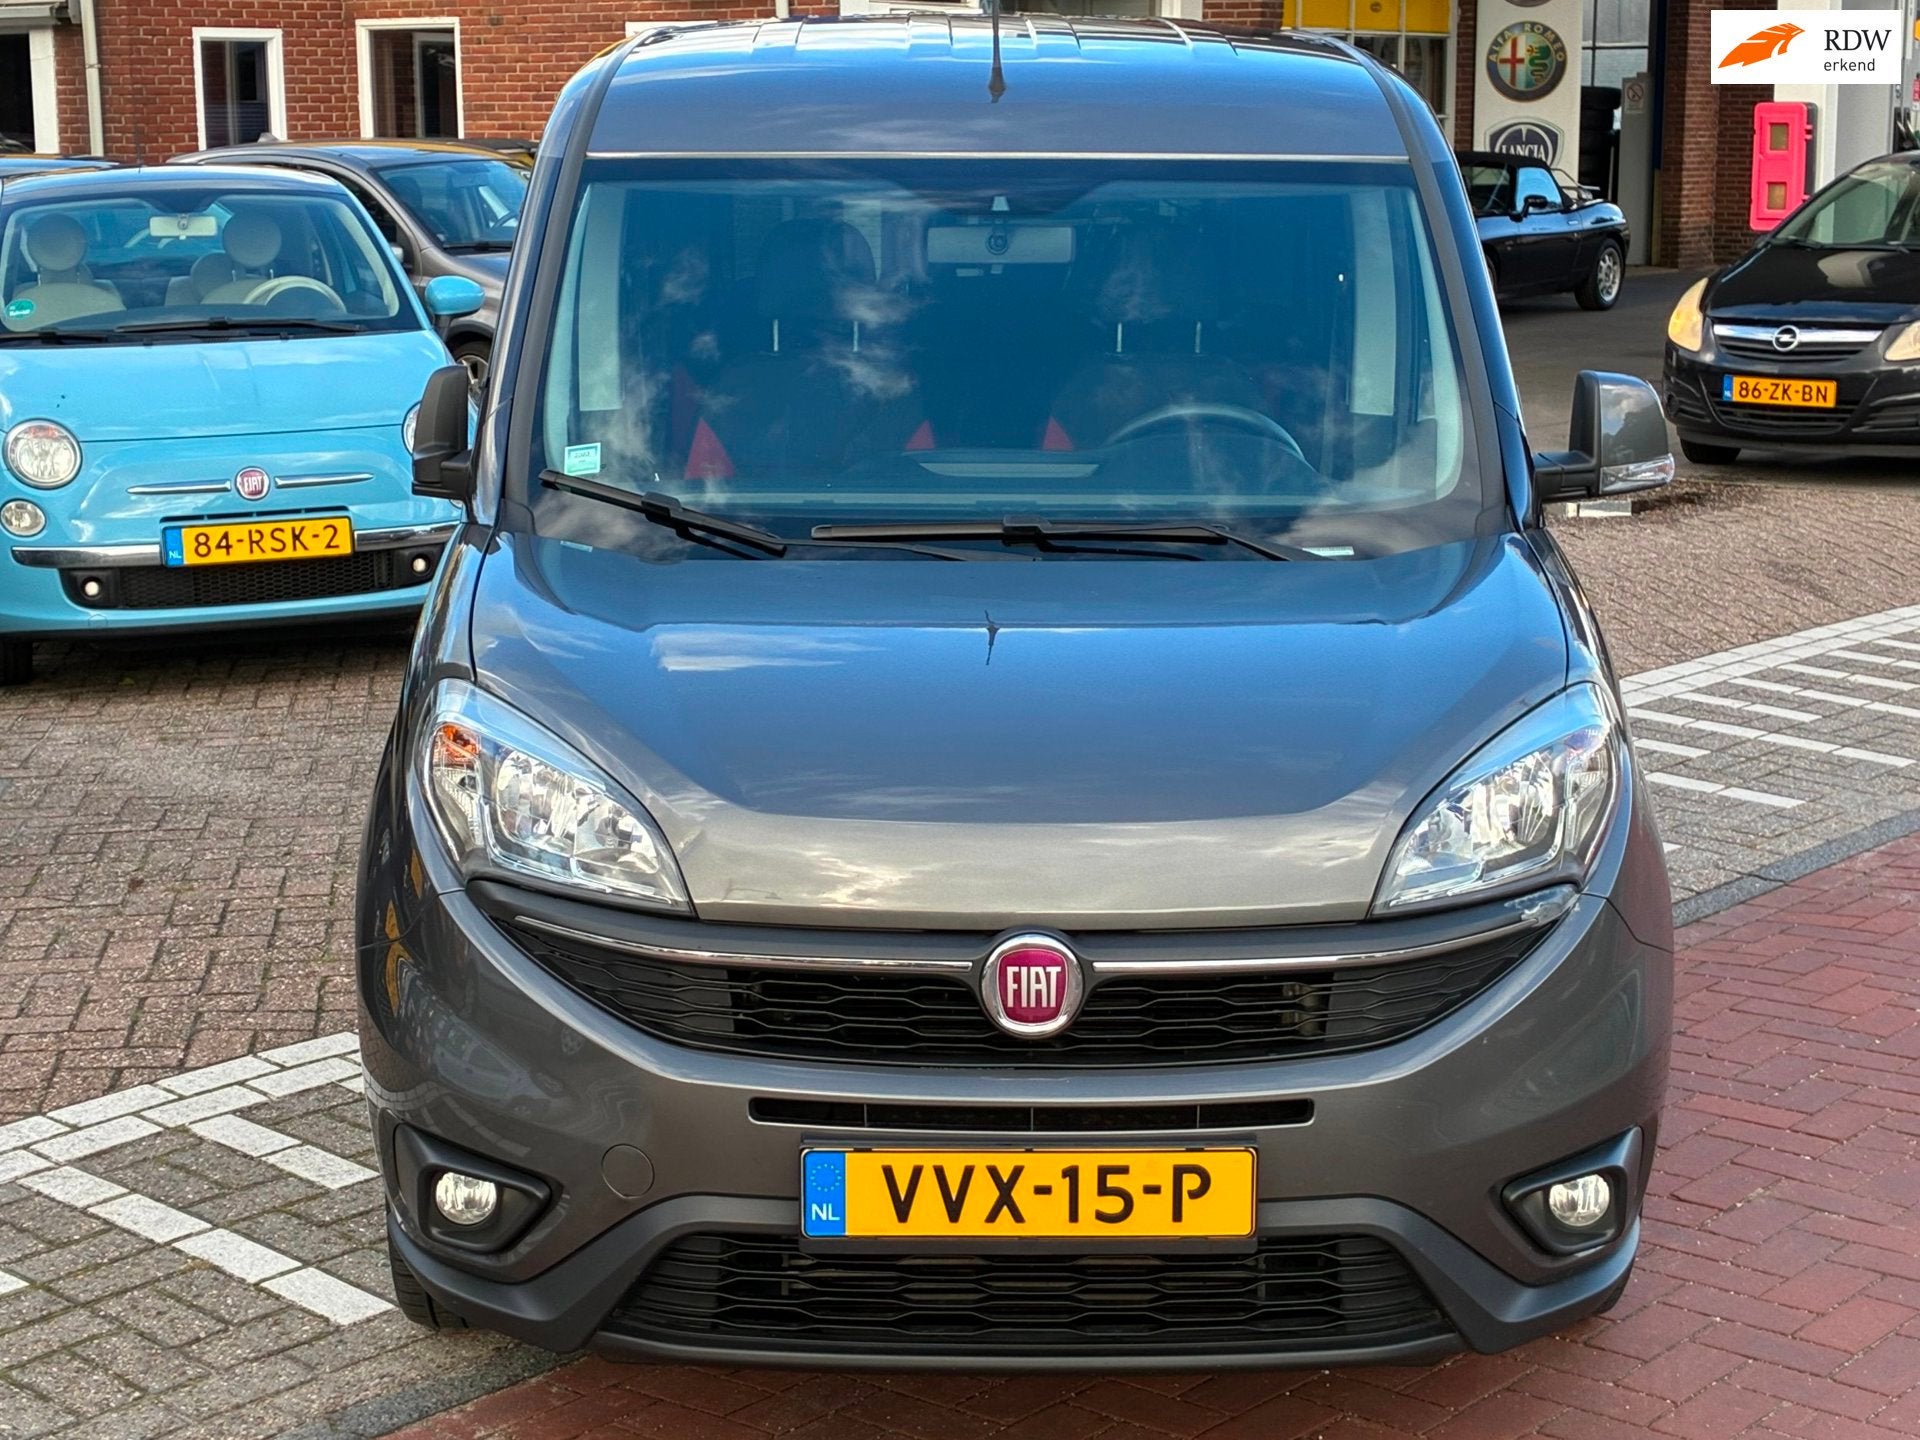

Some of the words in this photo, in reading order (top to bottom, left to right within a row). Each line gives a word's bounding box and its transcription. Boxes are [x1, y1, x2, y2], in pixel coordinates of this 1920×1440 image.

[1489, 29, 1512, 62] ALFA
[1524, 23, 1565, 62] ROMEO
[1738, 381, 1828, 403] 86-ZK-BN
[243, 476, 263, 492] FIAT
[169, 551, 182, 559] NL
[194, 524, 340, 558] 84-RSK-2
[1006, 966, 1061, 1008] FIAT
[811, 1203, 840, 1221] NL
[881, 1164, 1212, 1224] VVX-15-P
